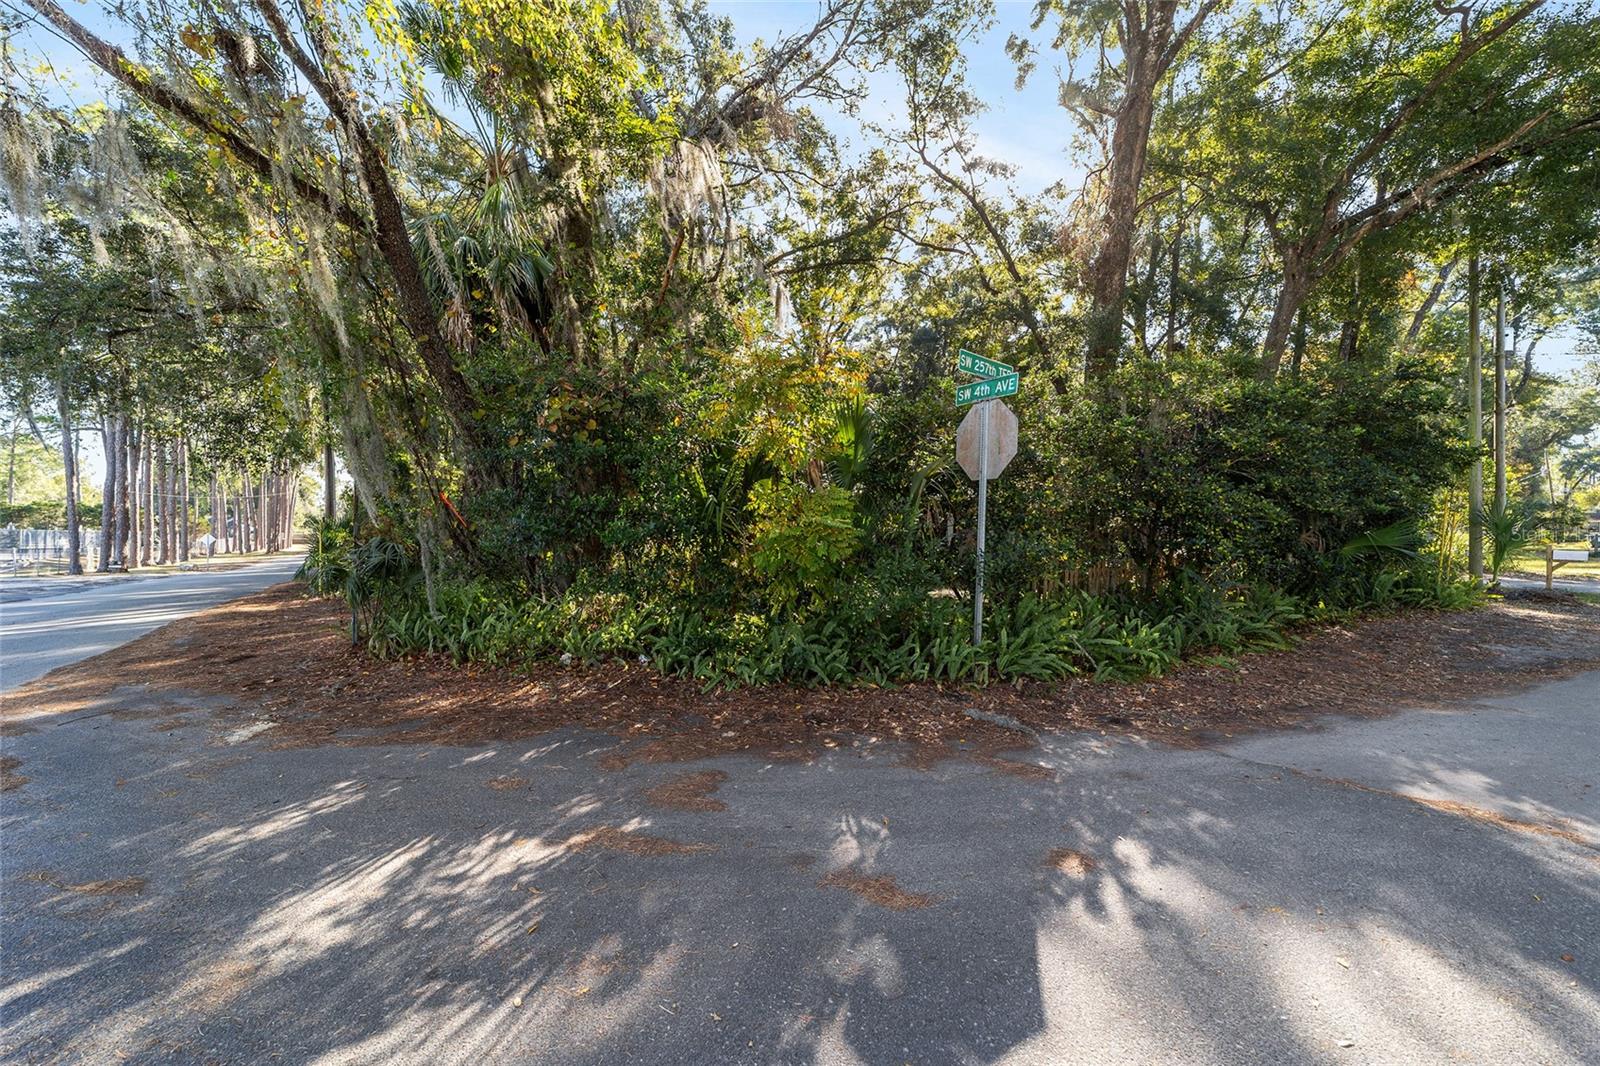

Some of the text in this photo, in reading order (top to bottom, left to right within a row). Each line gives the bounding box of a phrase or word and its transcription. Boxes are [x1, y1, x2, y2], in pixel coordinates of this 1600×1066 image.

[960, 355, 973, 369] SW
[974, 360, 997, 377] 257th
[958, 378, 1016, 401] SW 4th AVE
